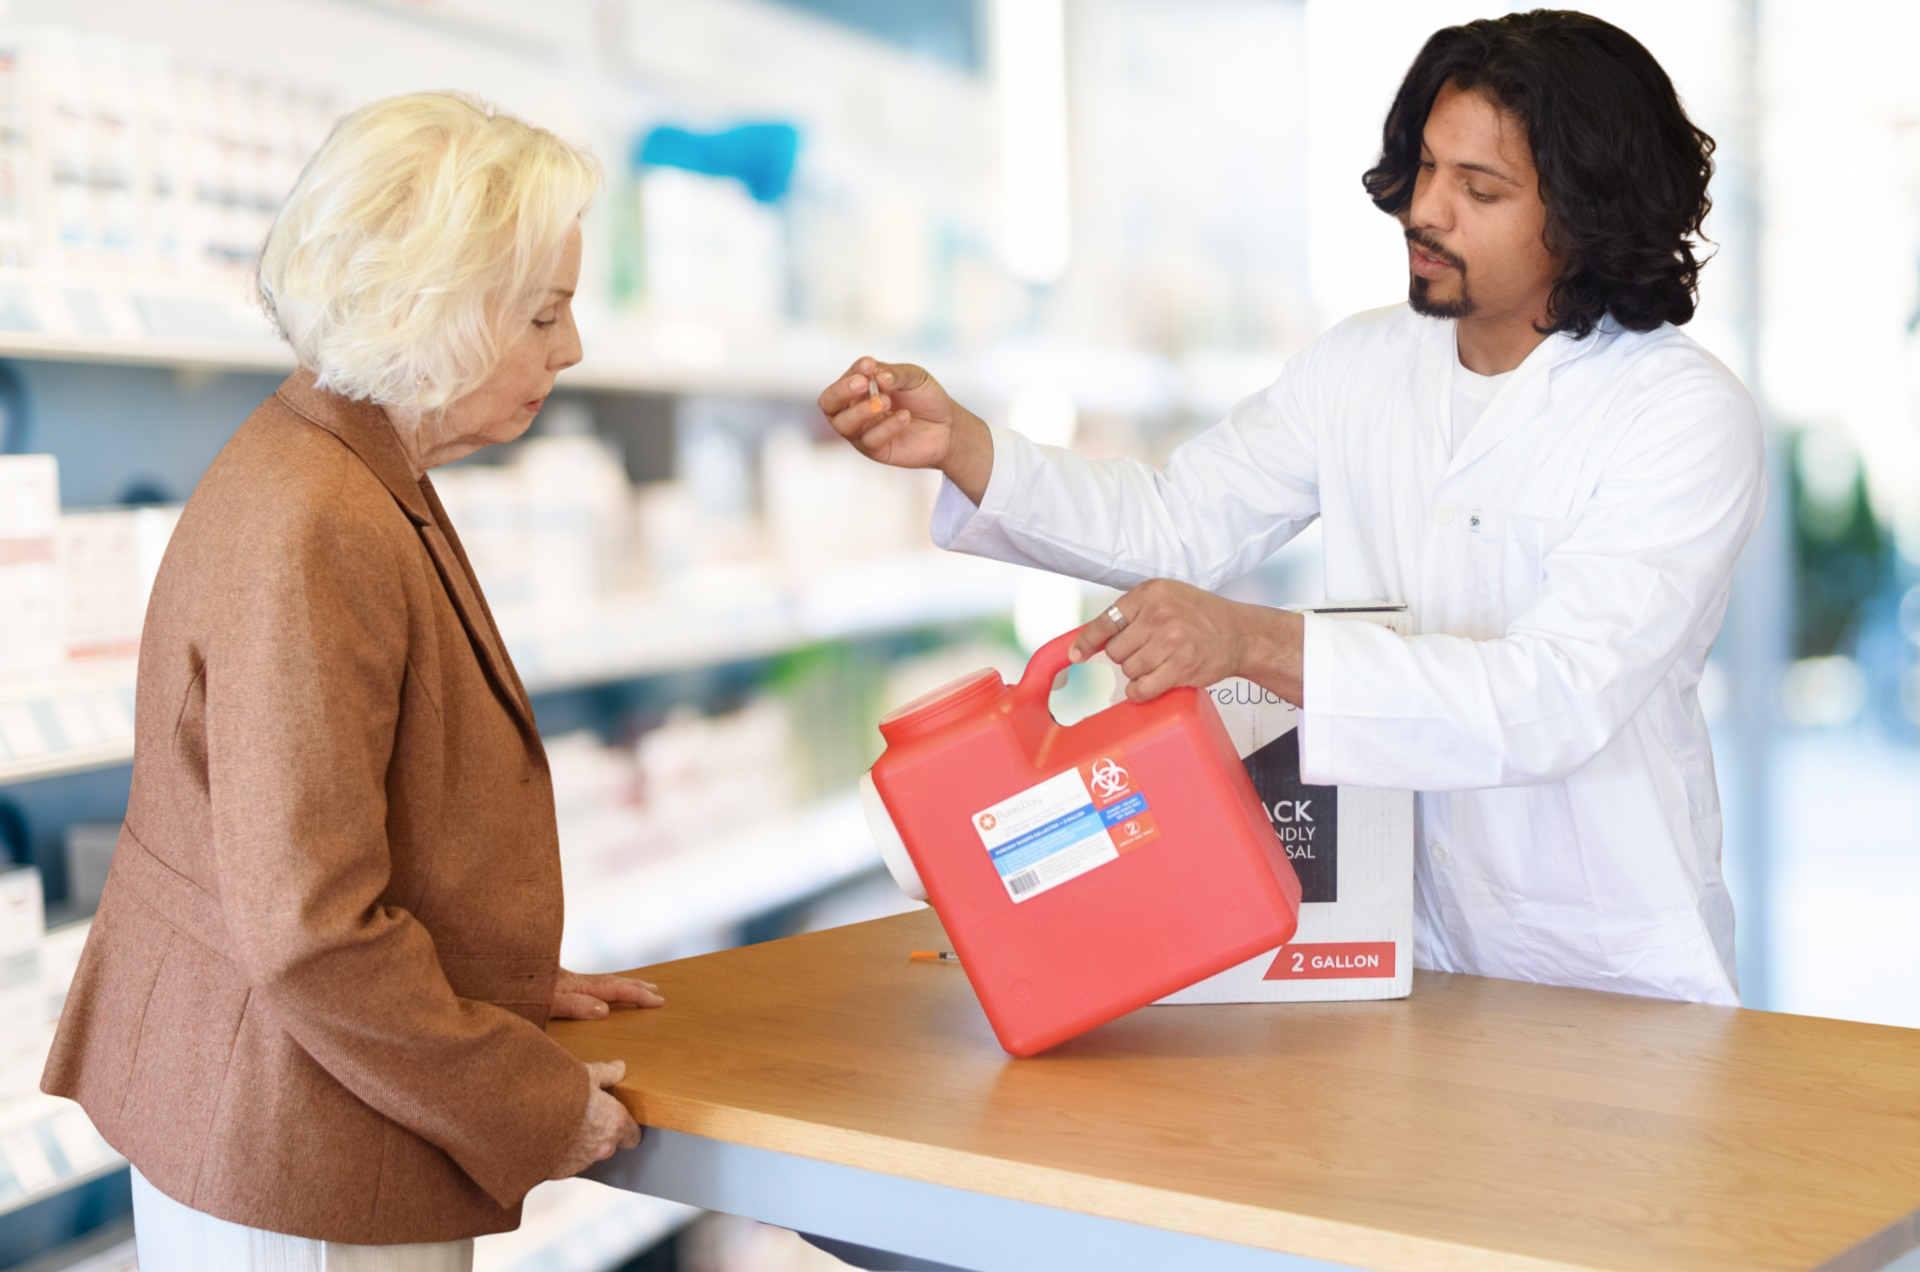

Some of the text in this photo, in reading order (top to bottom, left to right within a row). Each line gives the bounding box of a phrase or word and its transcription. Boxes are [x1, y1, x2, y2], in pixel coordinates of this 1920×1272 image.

[1209, 682, 1296, 712] reWa
[1126, 822, 1138, 835] 2
[1285, 845, 1316, 859] SAL
[1291, 952, 1379, 972] 2 GALLON
